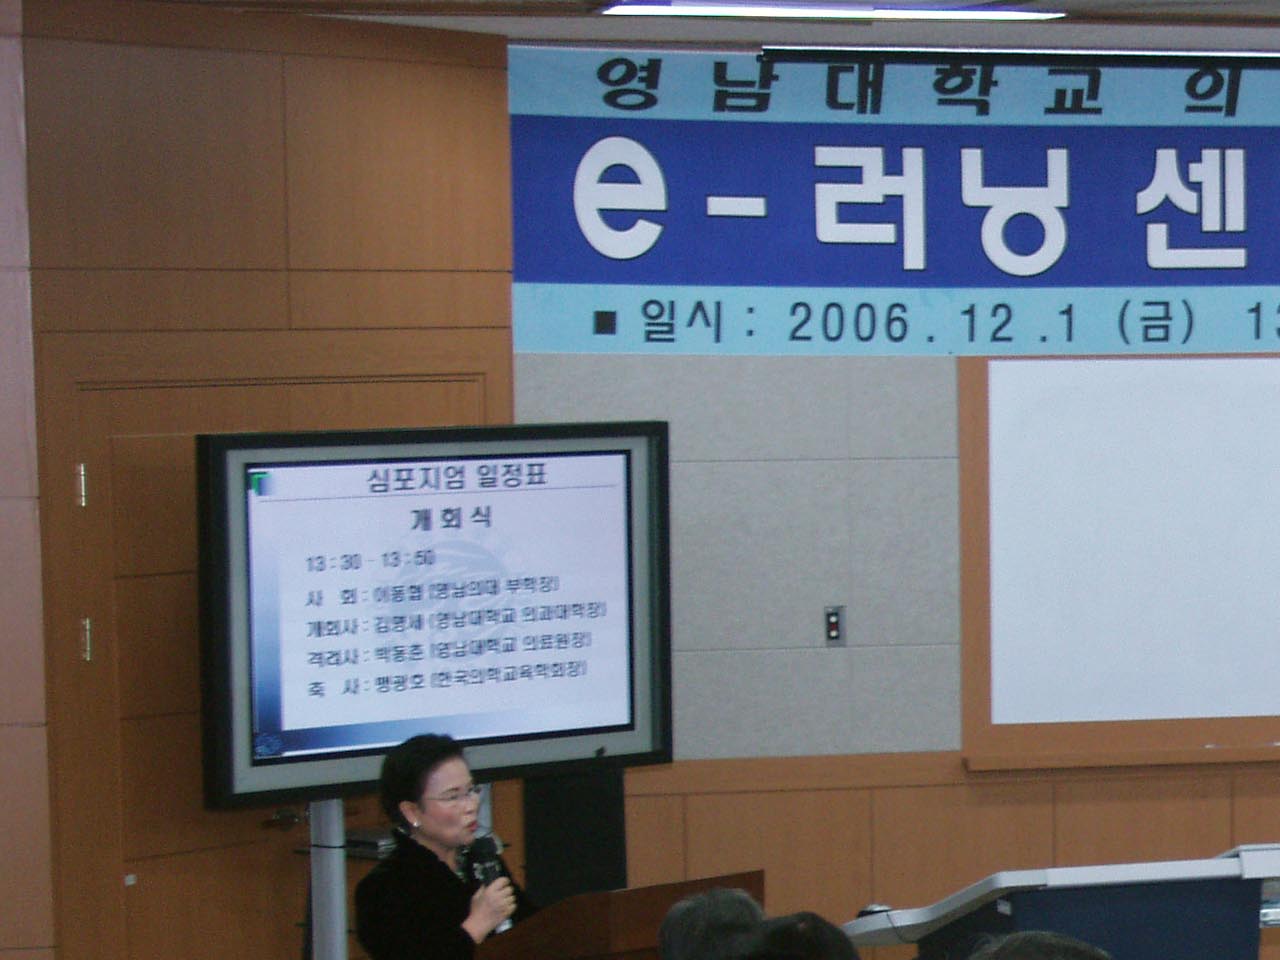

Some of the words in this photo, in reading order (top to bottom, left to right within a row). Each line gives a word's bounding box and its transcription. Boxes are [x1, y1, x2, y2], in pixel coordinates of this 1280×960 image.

[596, 57, 1104, 116] 영남대학교
[1118, 300, 1196, 344] (금)
[367, 466, 466, 493] 심포지엄
[476, 463, 548, 489] 일정표
